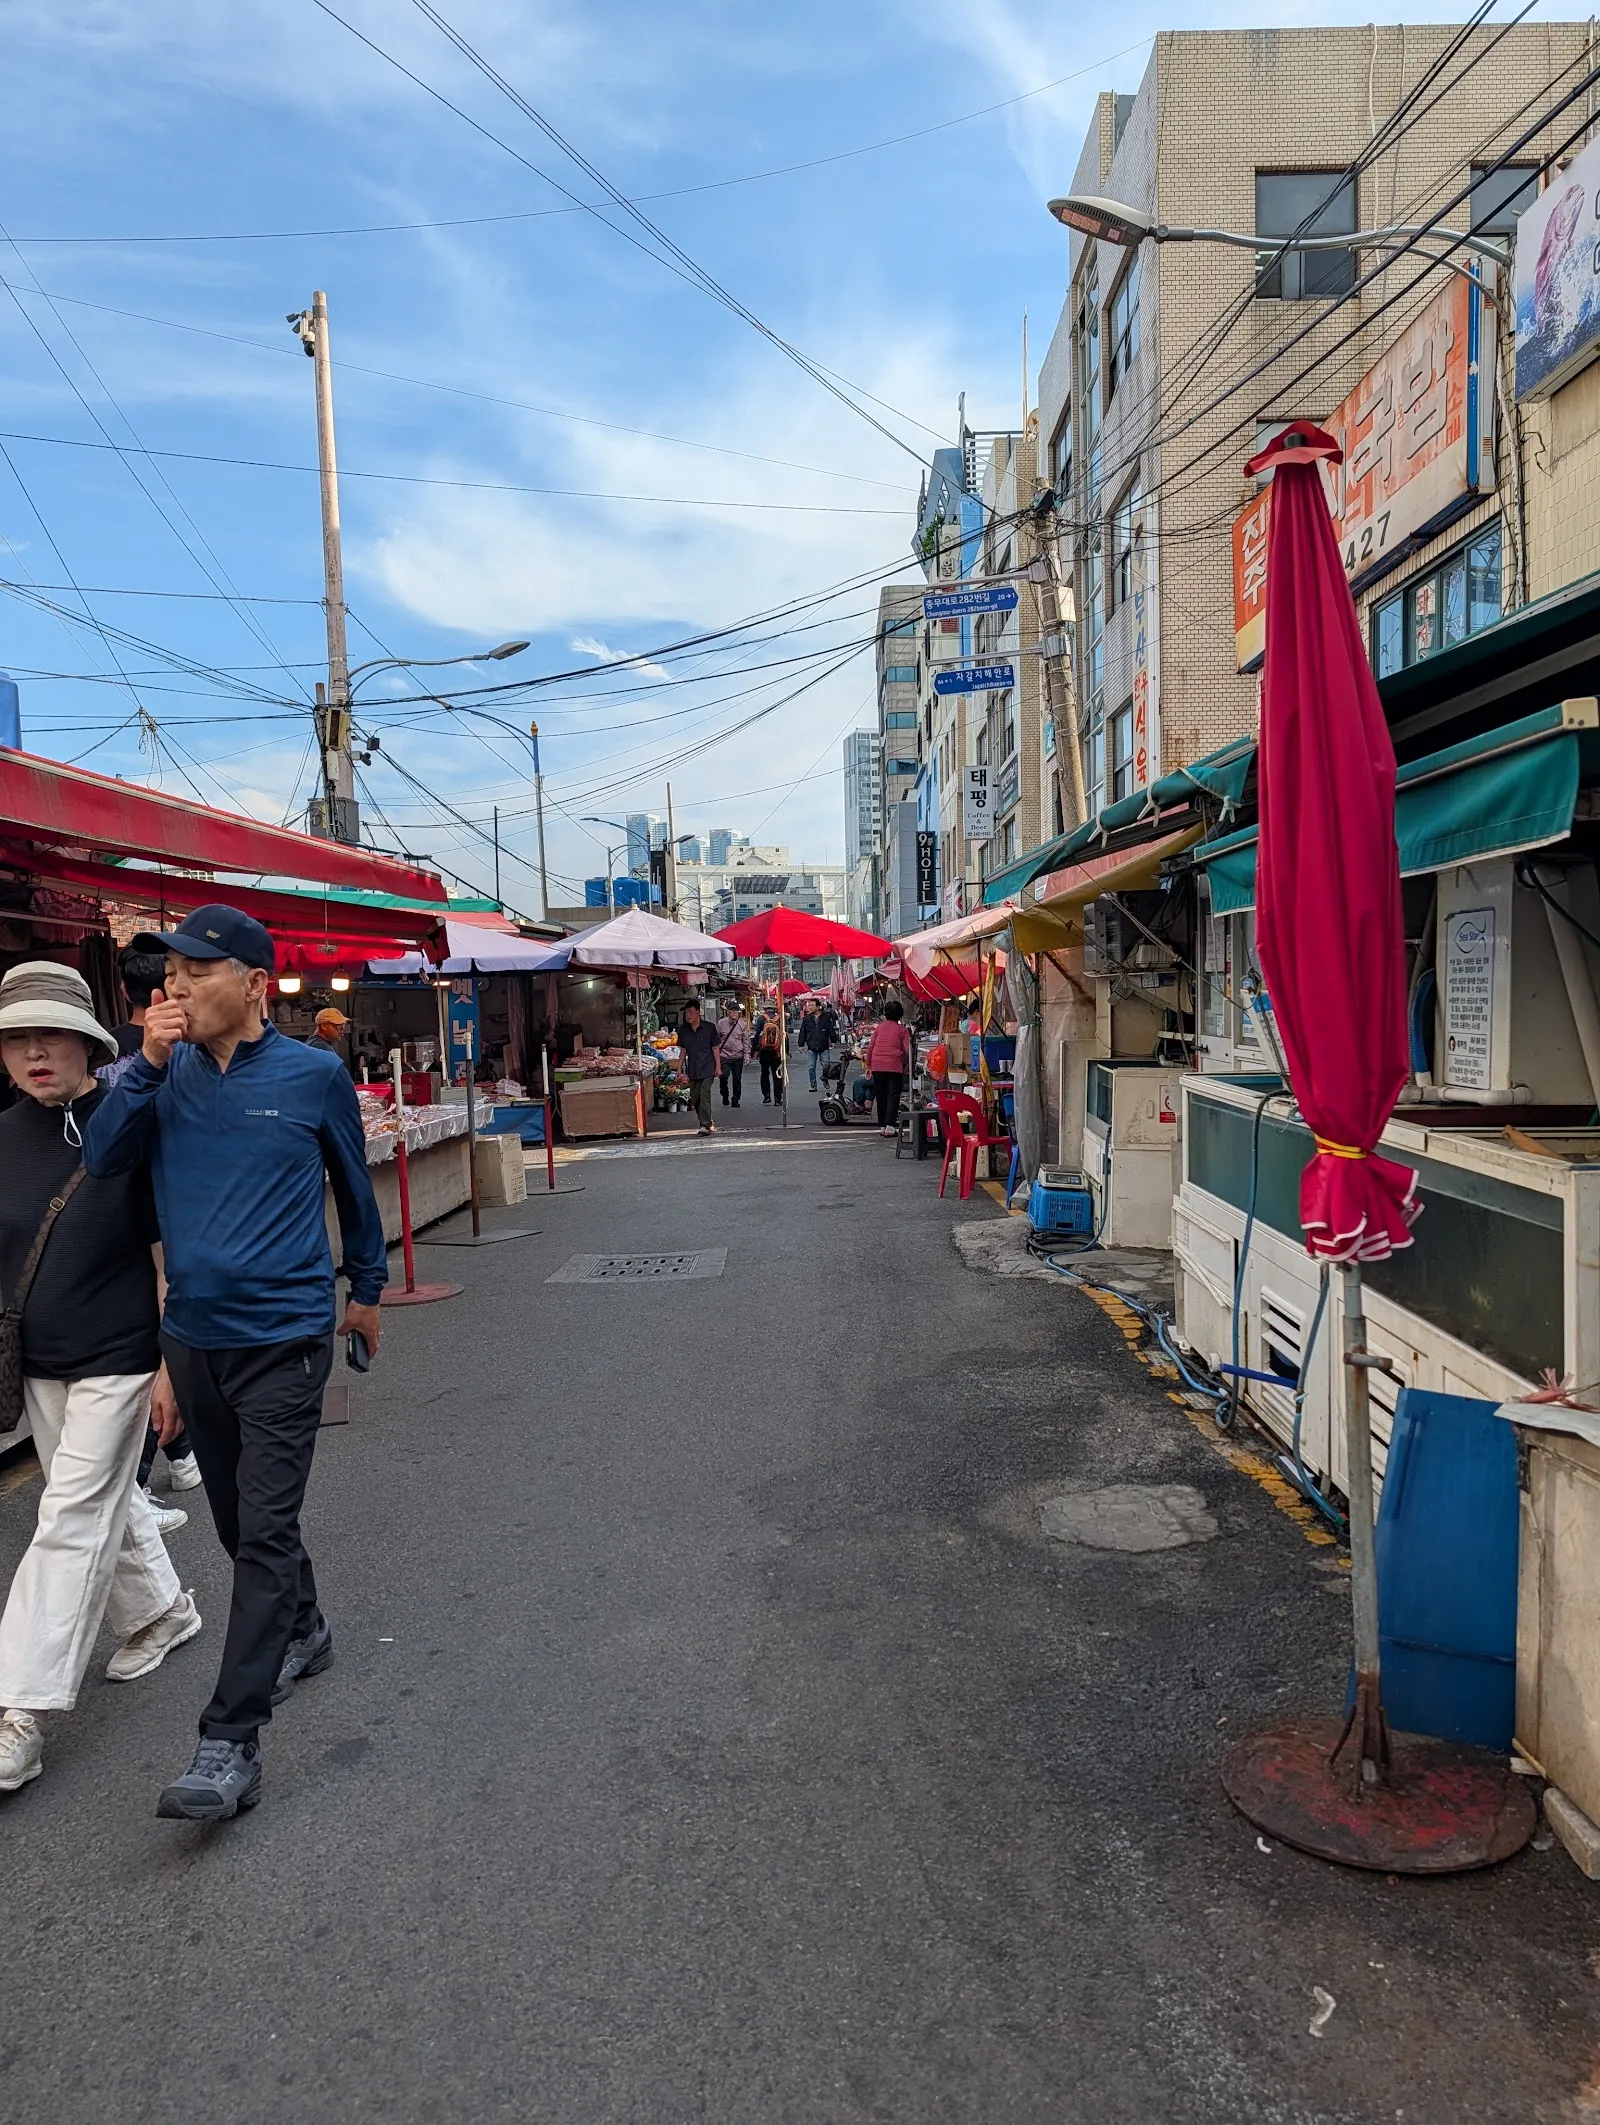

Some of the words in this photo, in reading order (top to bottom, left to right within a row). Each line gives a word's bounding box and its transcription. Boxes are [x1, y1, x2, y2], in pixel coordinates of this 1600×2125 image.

[926, 592, 990, 609] 충무대로282번길
[967, 602, 998, 613] 282beon-gil
[1134, 584, 1146, 668] 부산
[956, 666, 1012, 682] 자갈치해안로
[1135, 700, 1147, 785] 식육
[970, 769, 987, 808] 태평
[920, 847, 932, 903] HOTEL
[265, 1109, 279, 1117] K2
